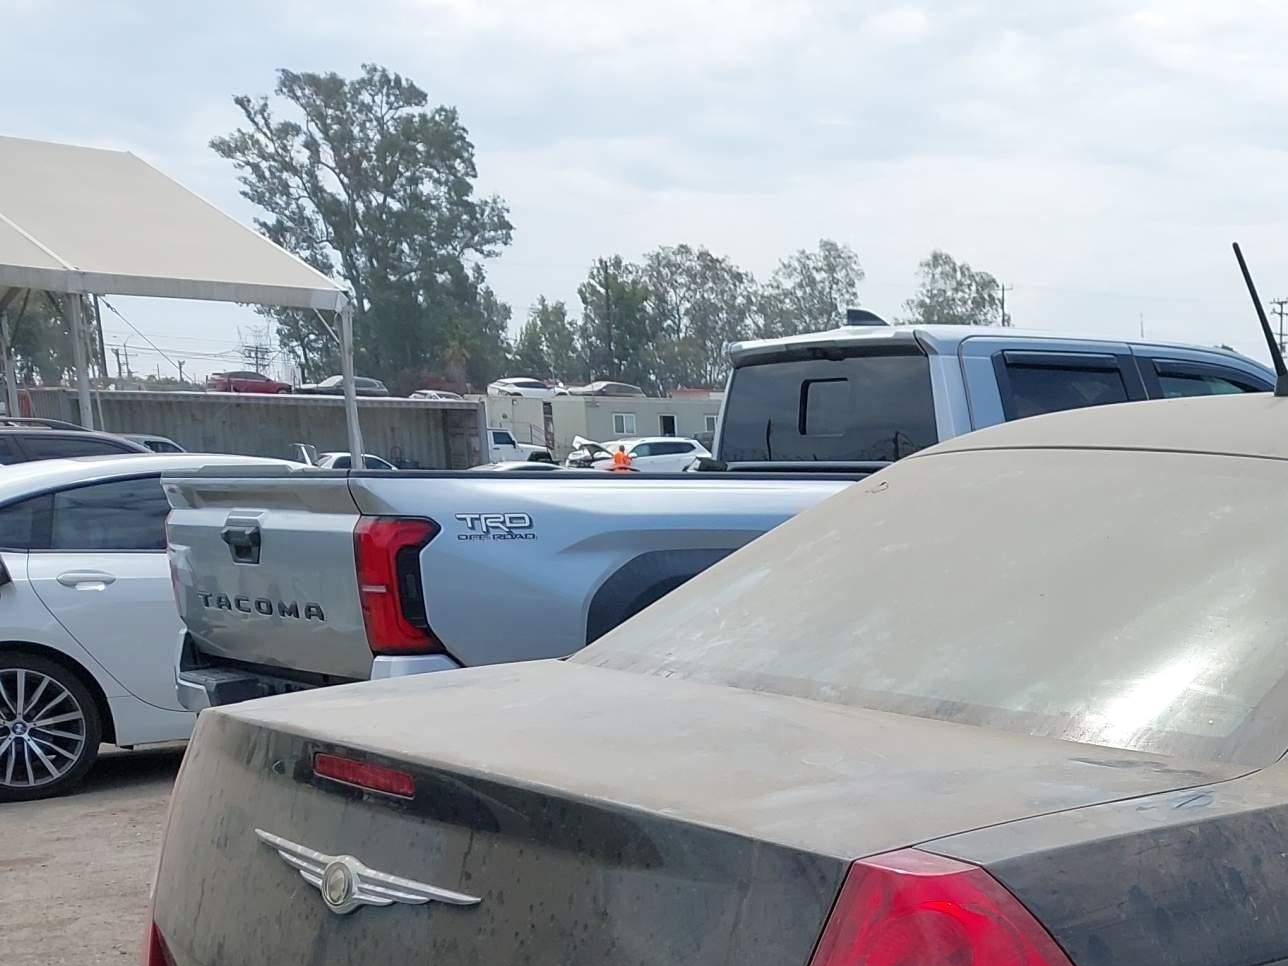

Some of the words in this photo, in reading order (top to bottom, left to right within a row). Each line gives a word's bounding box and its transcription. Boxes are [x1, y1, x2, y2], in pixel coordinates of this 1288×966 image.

[455, 512, 534, 534] TRD
[457, 533, 490, 541] OFF
[492, 533, 536, 541] ROAD
[198, 591, 326, 622] TACOMA
